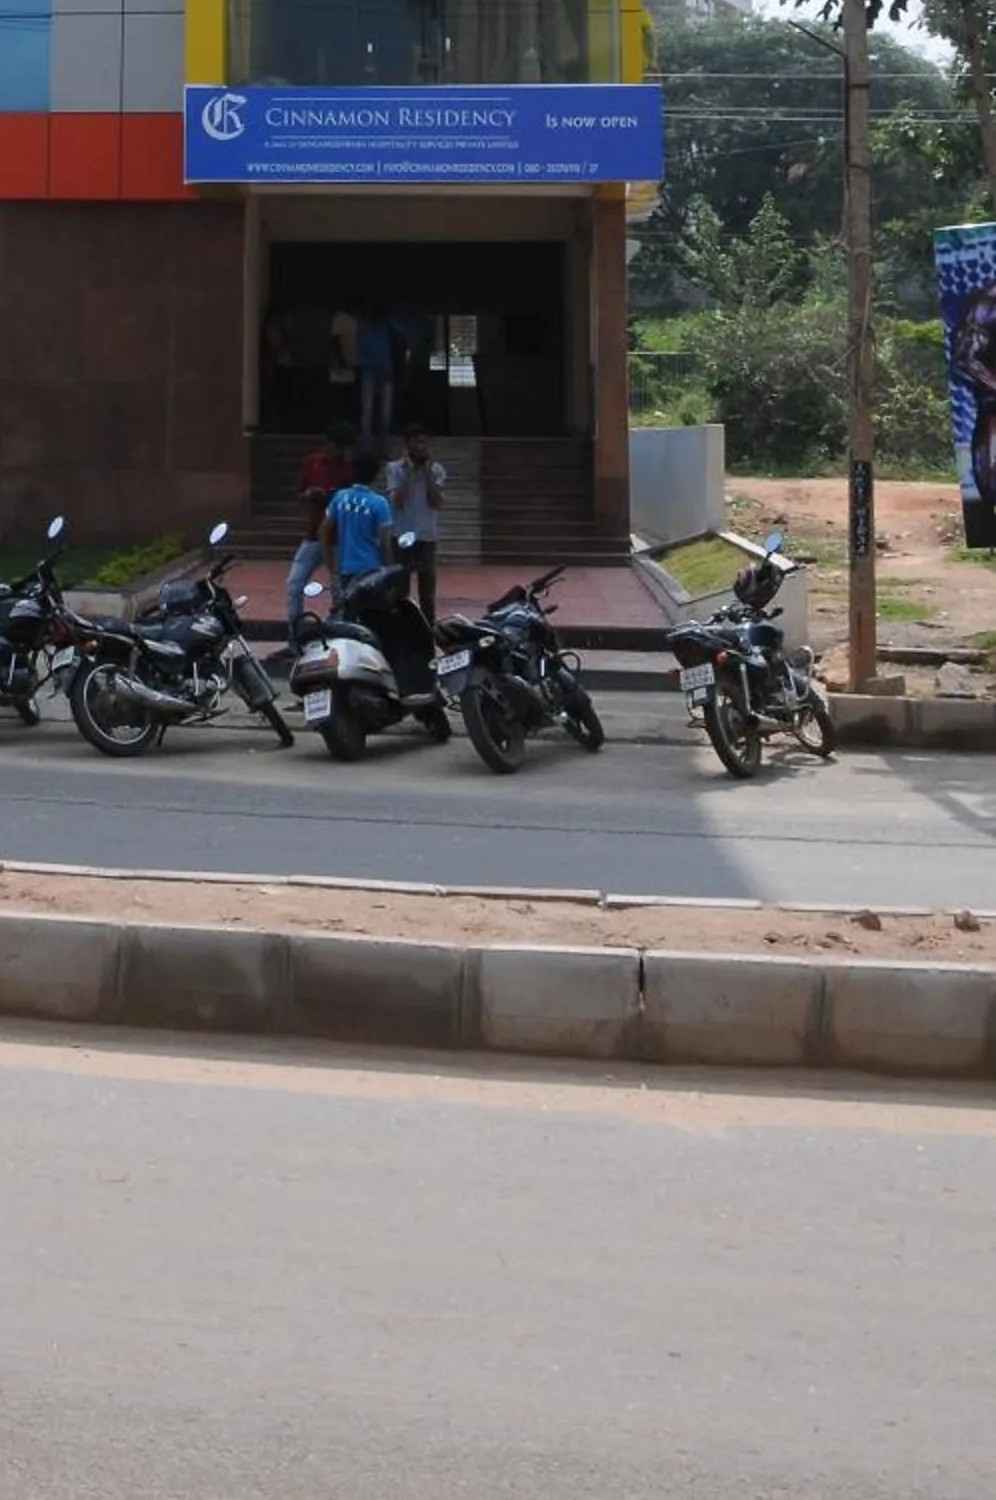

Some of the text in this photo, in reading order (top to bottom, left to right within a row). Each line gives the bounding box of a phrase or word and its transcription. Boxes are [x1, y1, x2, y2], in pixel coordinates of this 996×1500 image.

[265, 107, 518, 127] CINNAMON RESIDENCY
[561, 115, 596, 129] NOW
[600, 115, 638, 129] OPEN
